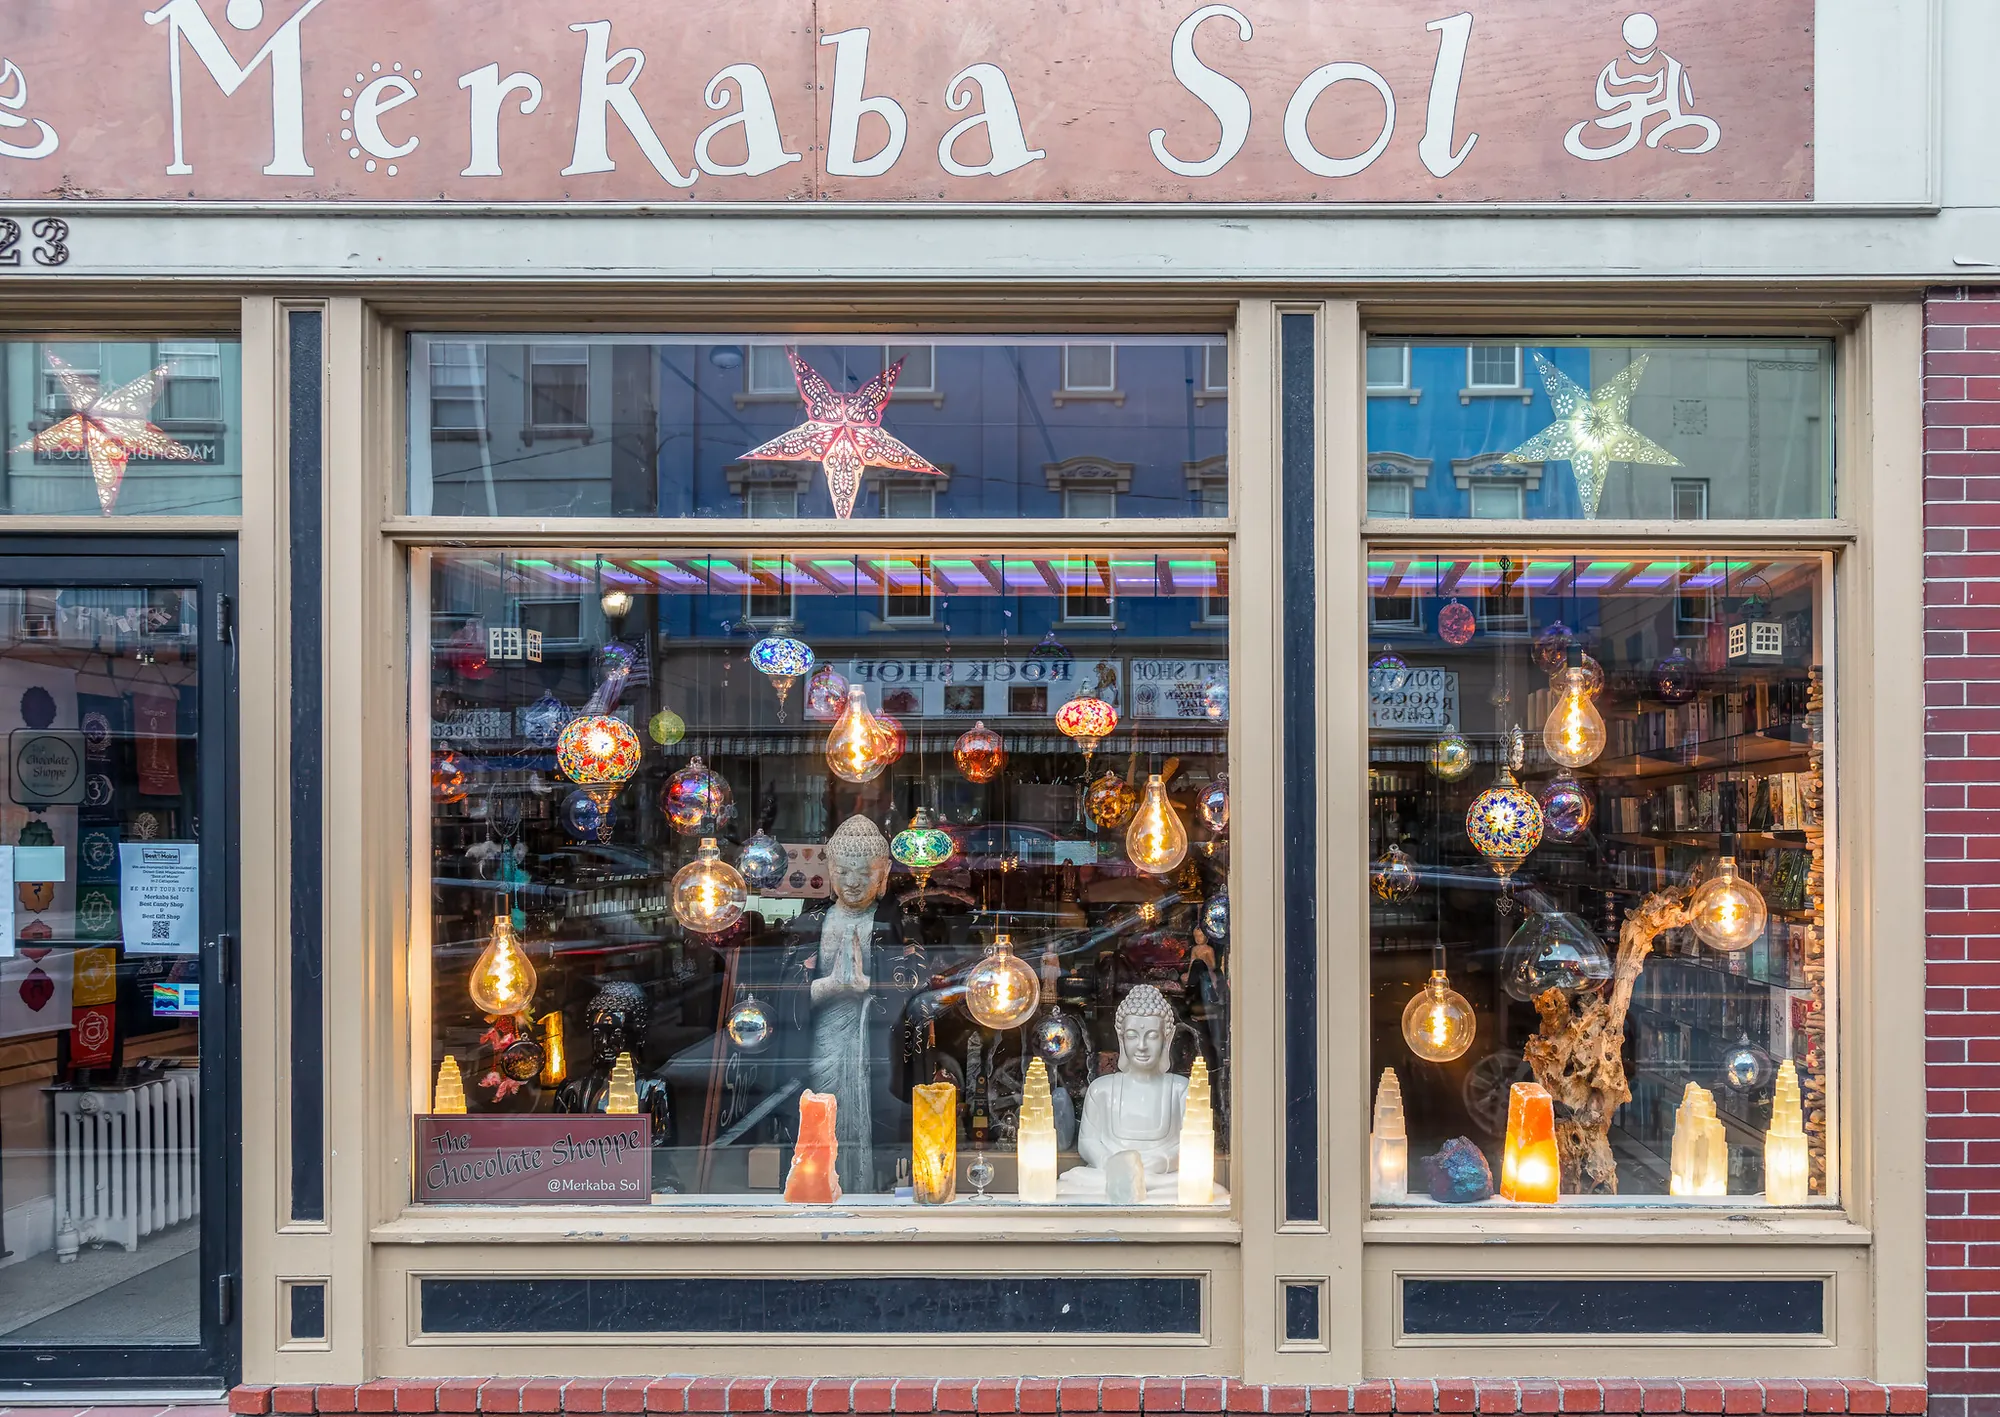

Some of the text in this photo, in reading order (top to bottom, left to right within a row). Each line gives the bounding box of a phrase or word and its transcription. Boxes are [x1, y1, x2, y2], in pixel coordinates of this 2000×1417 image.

[144, 0, 1479, 188] Merkaba Sol
[426, 1129, 641, 1191] Chocolate Shoppe
[431, 1129, 471, 1155] The
[547, 1179, 640, 1193] @Merkaba Sol
